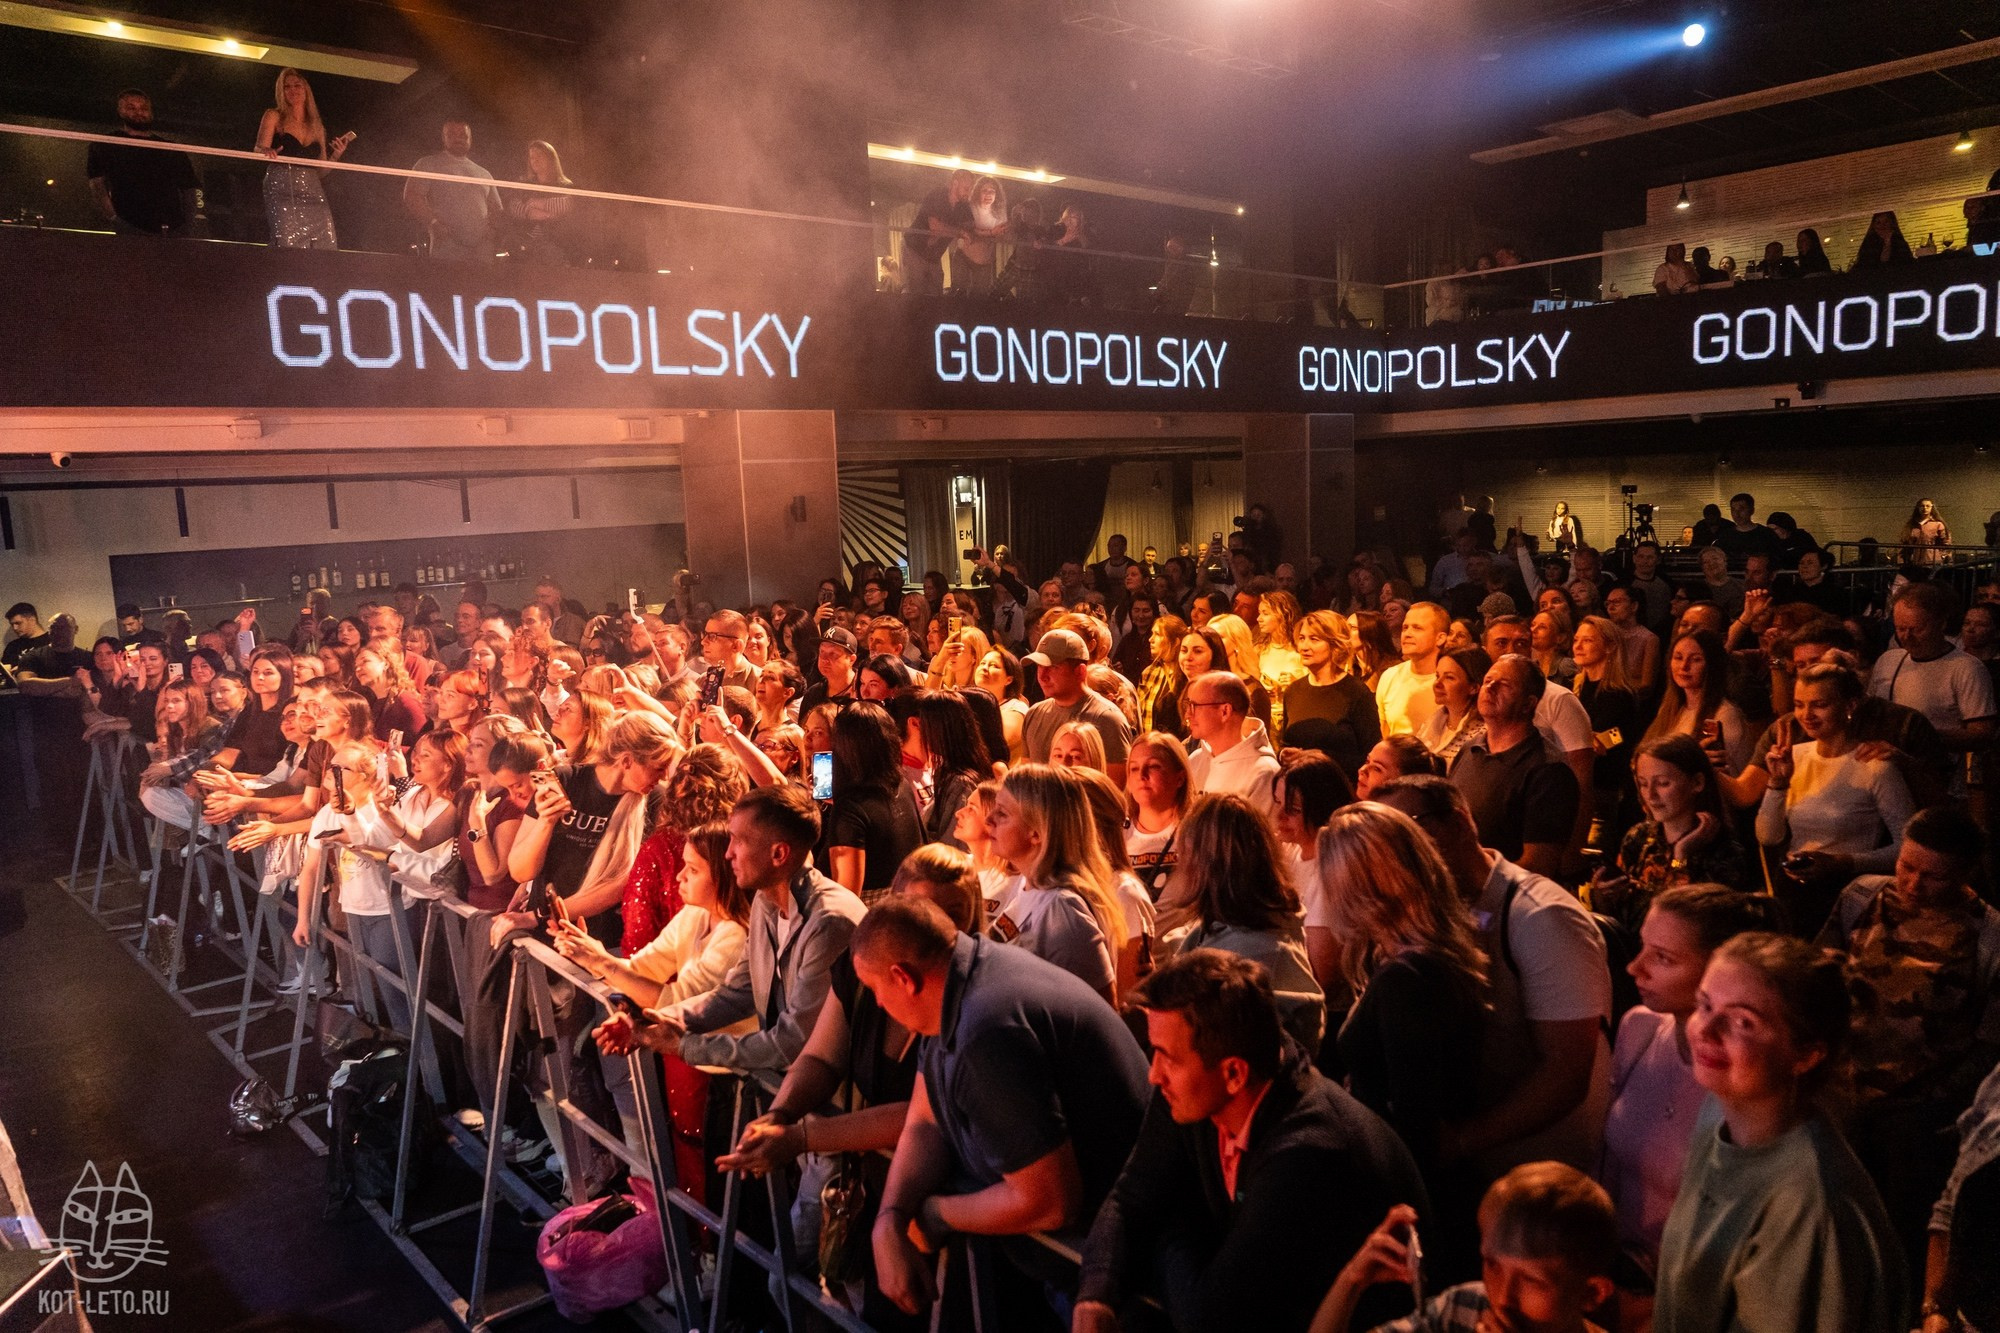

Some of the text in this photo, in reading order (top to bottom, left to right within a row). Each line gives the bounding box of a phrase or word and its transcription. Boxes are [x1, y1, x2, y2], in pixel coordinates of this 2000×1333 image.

[267, 285, 812, 379] GONOPOLSKY
[934, 323, 1229, 390] GONOPOLSKY
[1298, 330, 1571, 394] GONOPOLSKY
[1692, 284, 2000, 366] GONOPO
